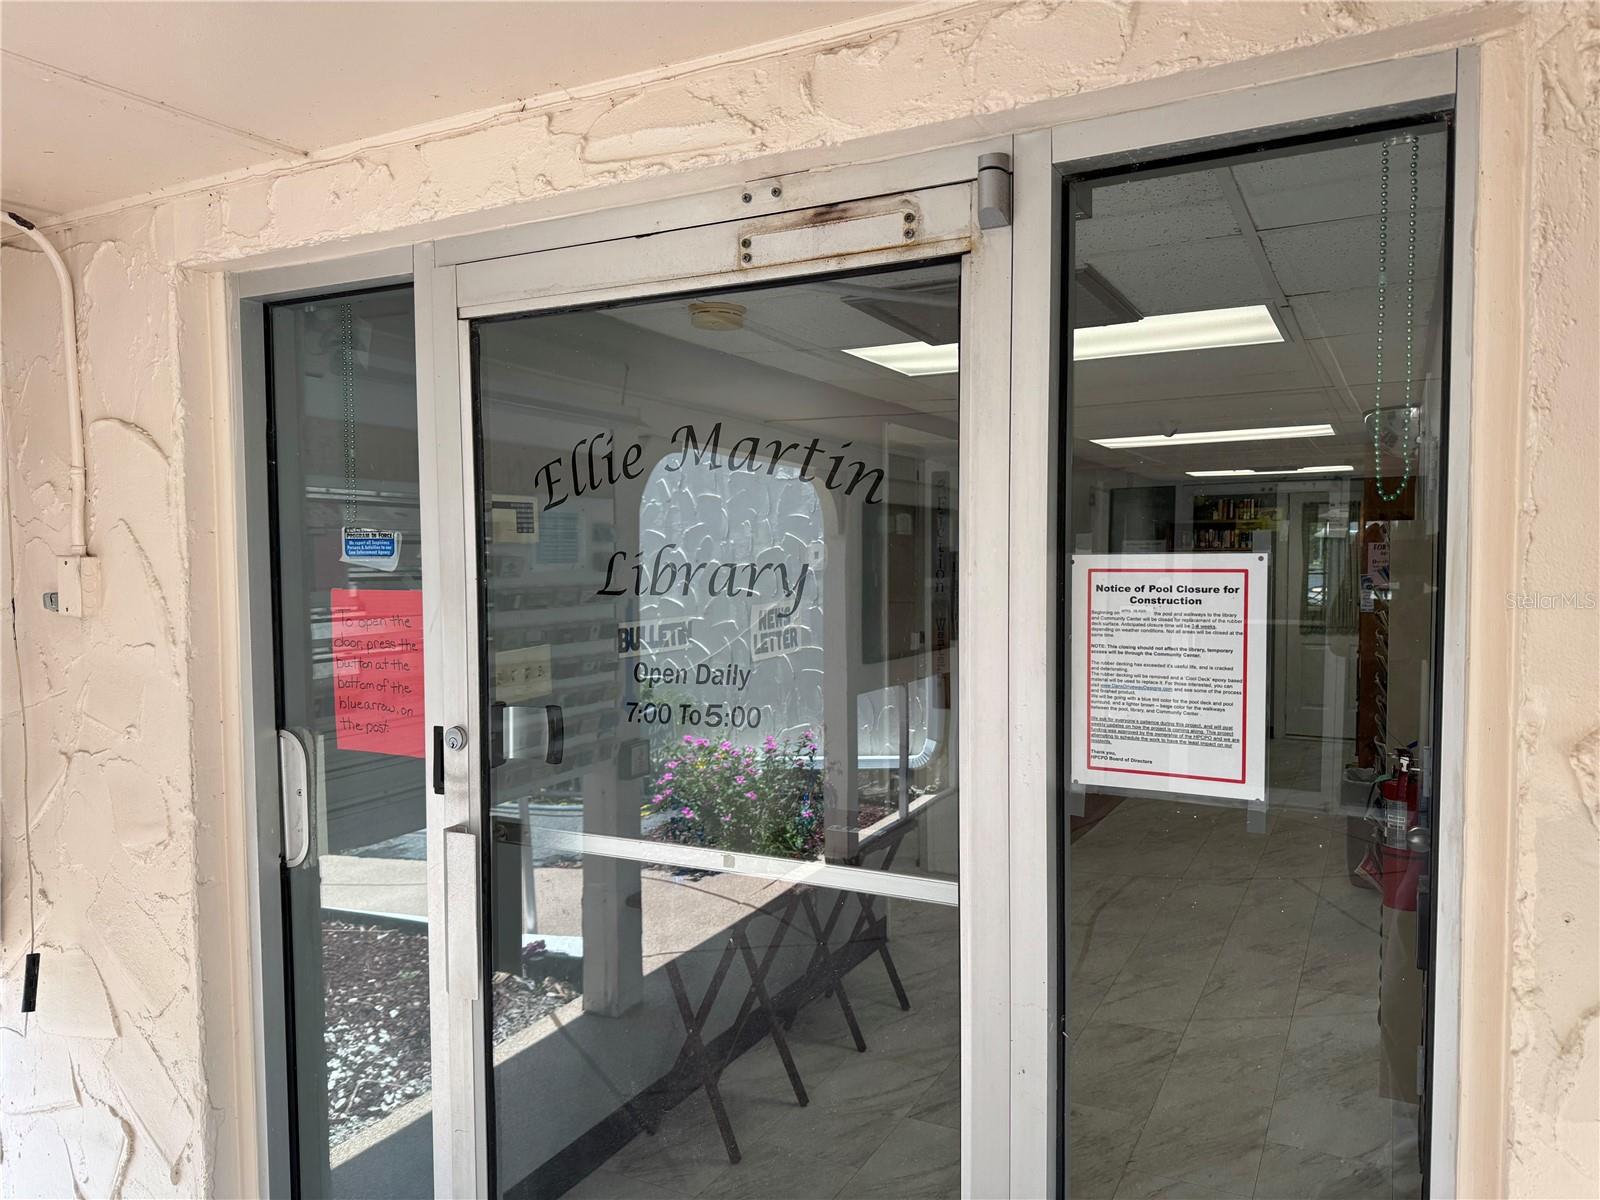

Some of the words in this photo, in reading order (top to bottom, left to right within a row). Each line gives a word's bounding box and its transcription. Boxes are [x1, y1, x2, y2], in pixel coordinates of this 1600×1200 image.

[534, 432, 645, 512] Ellie
[664, 422, 885, 505] Martin
[596, 544, 809, 617] Library
[1096, 584, 1131, 592] Notice
[1134, 584, 1146, 592] of
[1176, 585, 1220, 594] Closure
[1223, 586, 1240, 594] for
[1129, 596, 1202, 604] Construction
[336, 609, 353, 628] To
[358, 618, 387, 632] open
[390, 615, 412, 628] the
[758, 606, 791, 631] NEWS
[334, 632, 363, 650] door,
[366, 638, 396, 654] press
[398, 638, 418, 651] the
[754, 626, 798, 654] LETTER
[336, 656, 372, 669] button
[376, 656, 388, 669] at
[390, 656, 410, 672] the
[337, 676, 374, 690] bottom
[376, 678, 390, 691] of
[390, 680, 412, 694] the
[634, 662, 688, 688] Open
[696, 664, 750, 690] Daily
[401, 708, 414, 716] on
[626, 702, 672, 724] 7:00
[680, 704, 702, 726] To
[704, 704, 762, 728] 5:00
[340, 716, 363, 731] the
